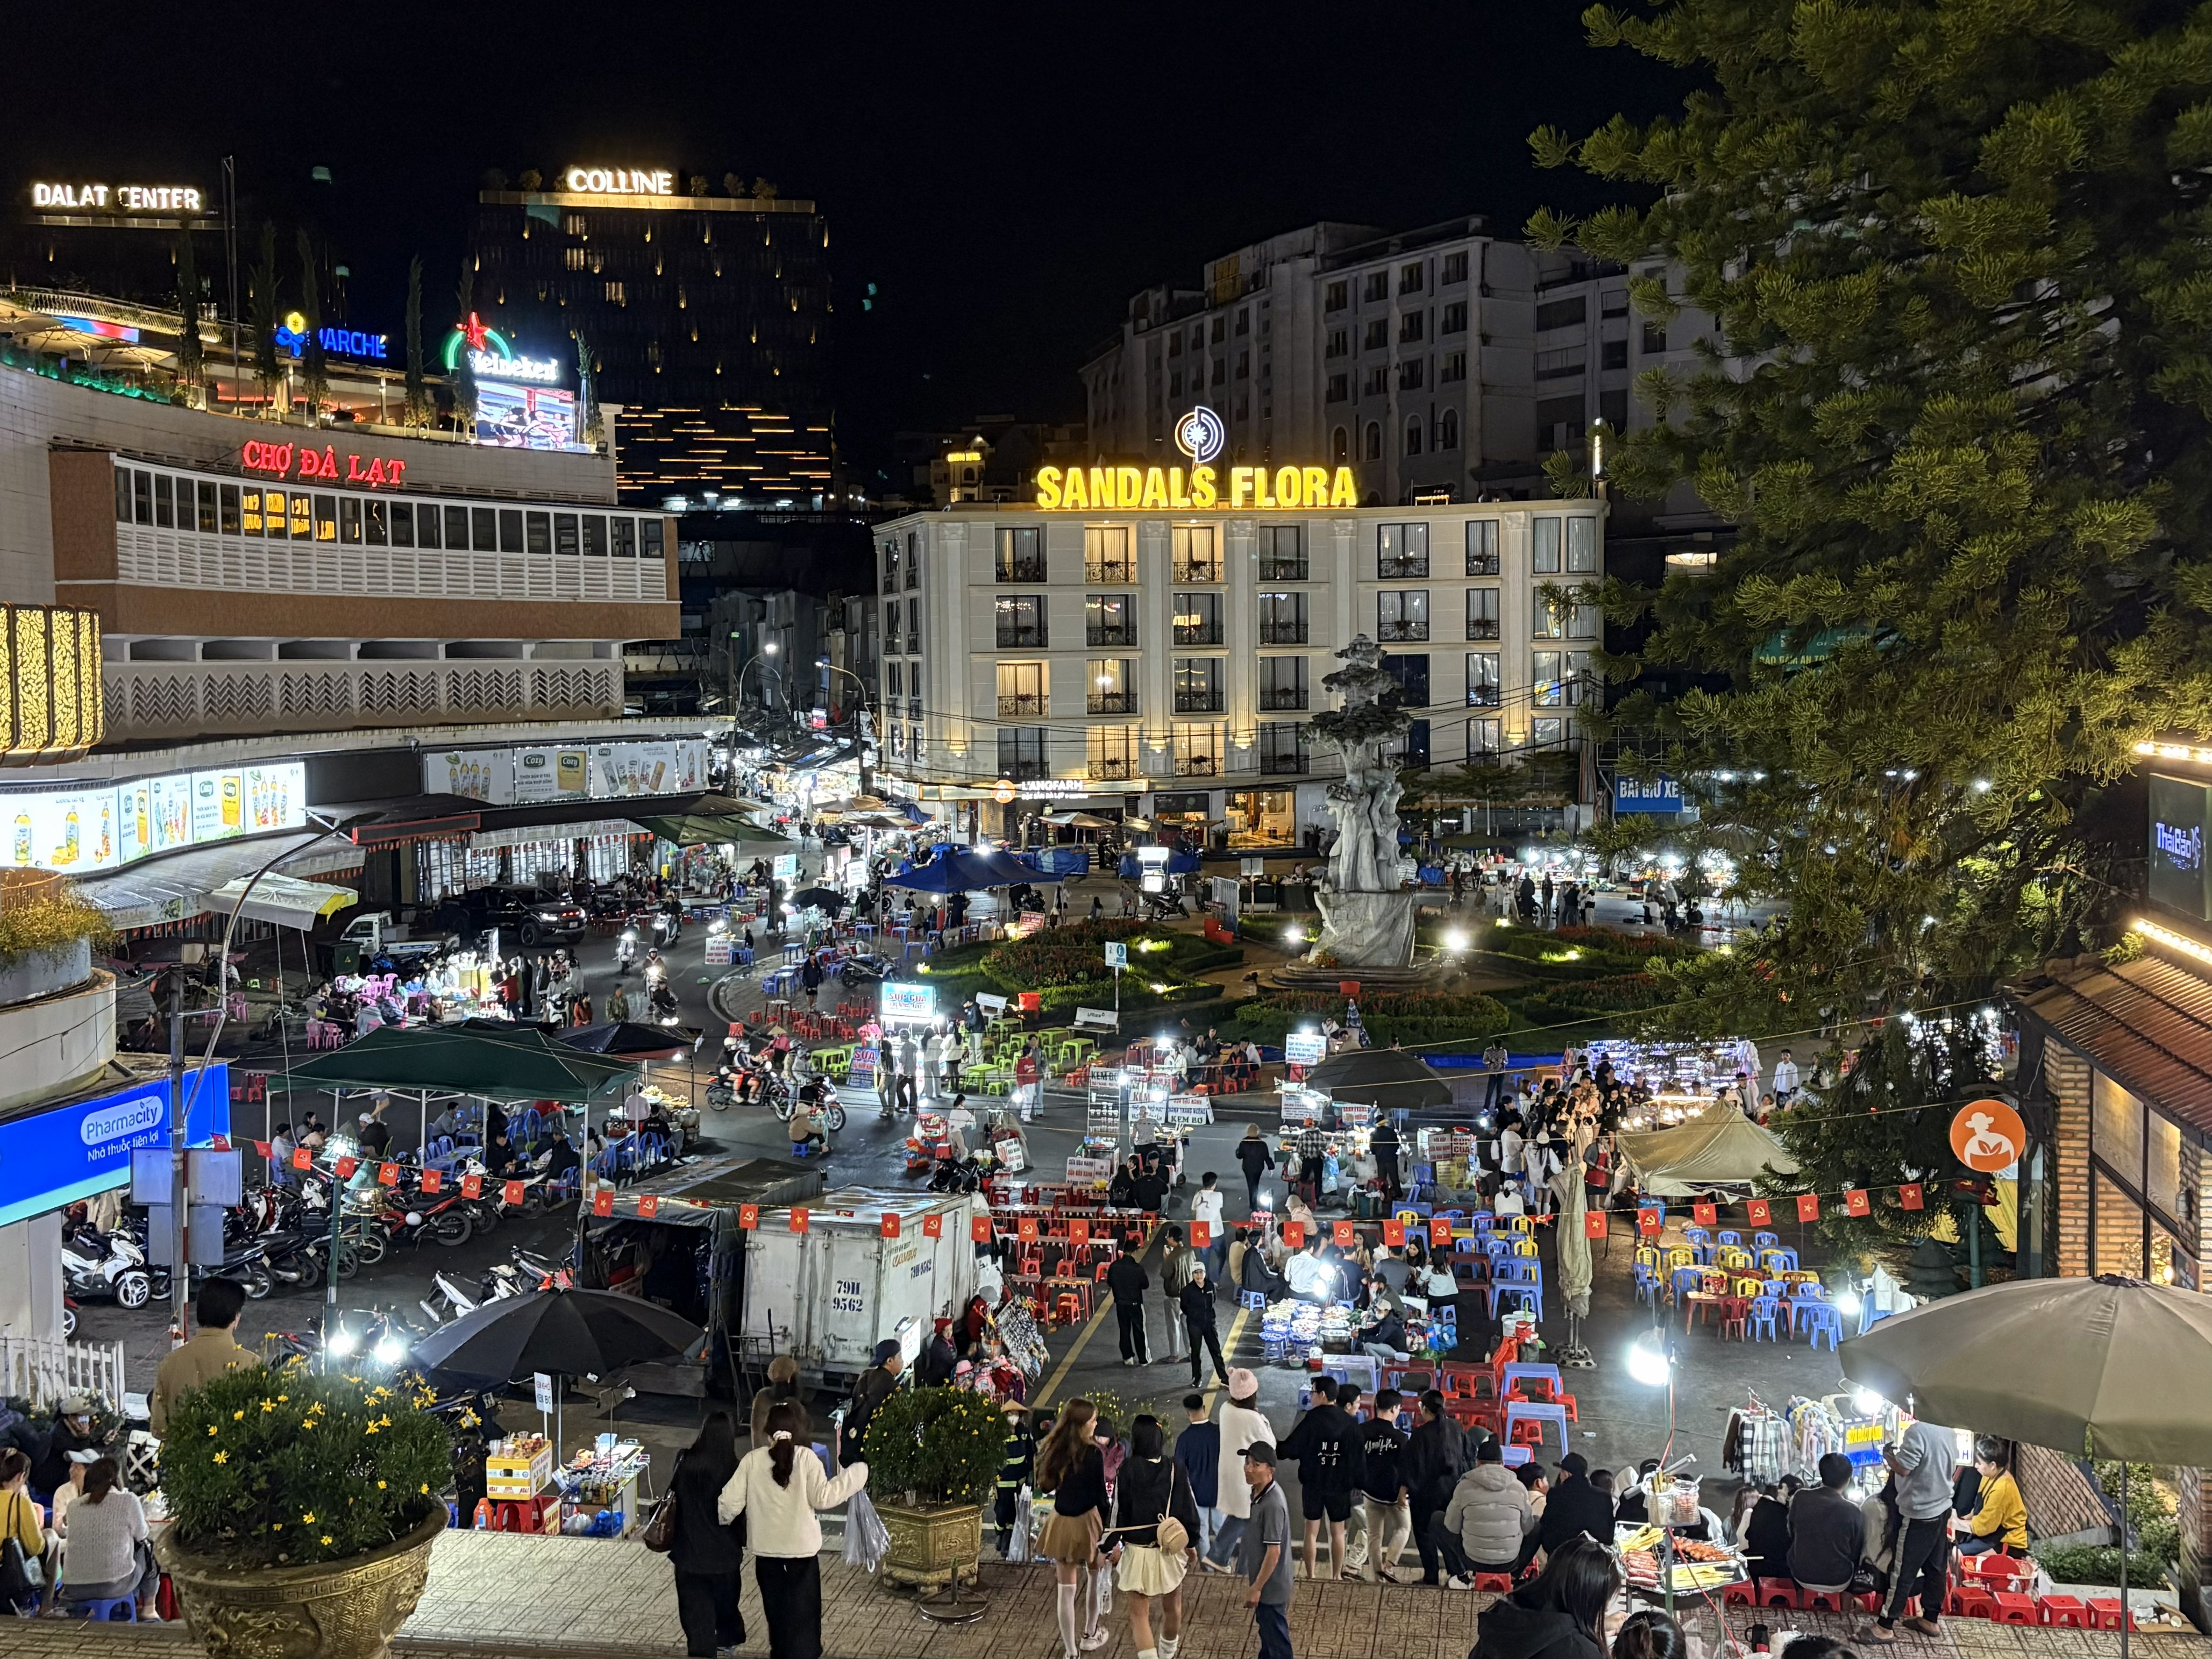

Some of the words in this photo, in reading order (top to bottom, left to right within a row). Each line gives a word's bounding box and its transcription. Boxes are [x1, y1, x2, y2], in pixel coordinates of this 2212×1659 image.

[568, 169, 672, 195] COLLINE
[34, 184, 109, 207] DALAT
[318, 327, 387, 358] ARCHÉ
[243, 440, 294, 479] CHỢ
[298, 444, 339, 479] ĐÀ
[347, 454, 406, 488] LẠT
[1036, 466, 1217, 509] SANDALS
[1231, 466, 1357, 508] FLORA
[526, 756, 544, 766] Cozy
[563, 757, 578, 767] Cozy
[1664, 781, 1679, 798] XE
[87, 1102, 158, 1140] Pharmacity
[1171, 1115, 1189, 1123] KEM
[88, 1146, 106, 1163] Nhà
[107, 1138, 131, 1156] thuốc
[150, 1130, 159, 1144] lợi
[837, 1280, 860, 1295] 79H
[833, 1297, 863, 1312] 9562
